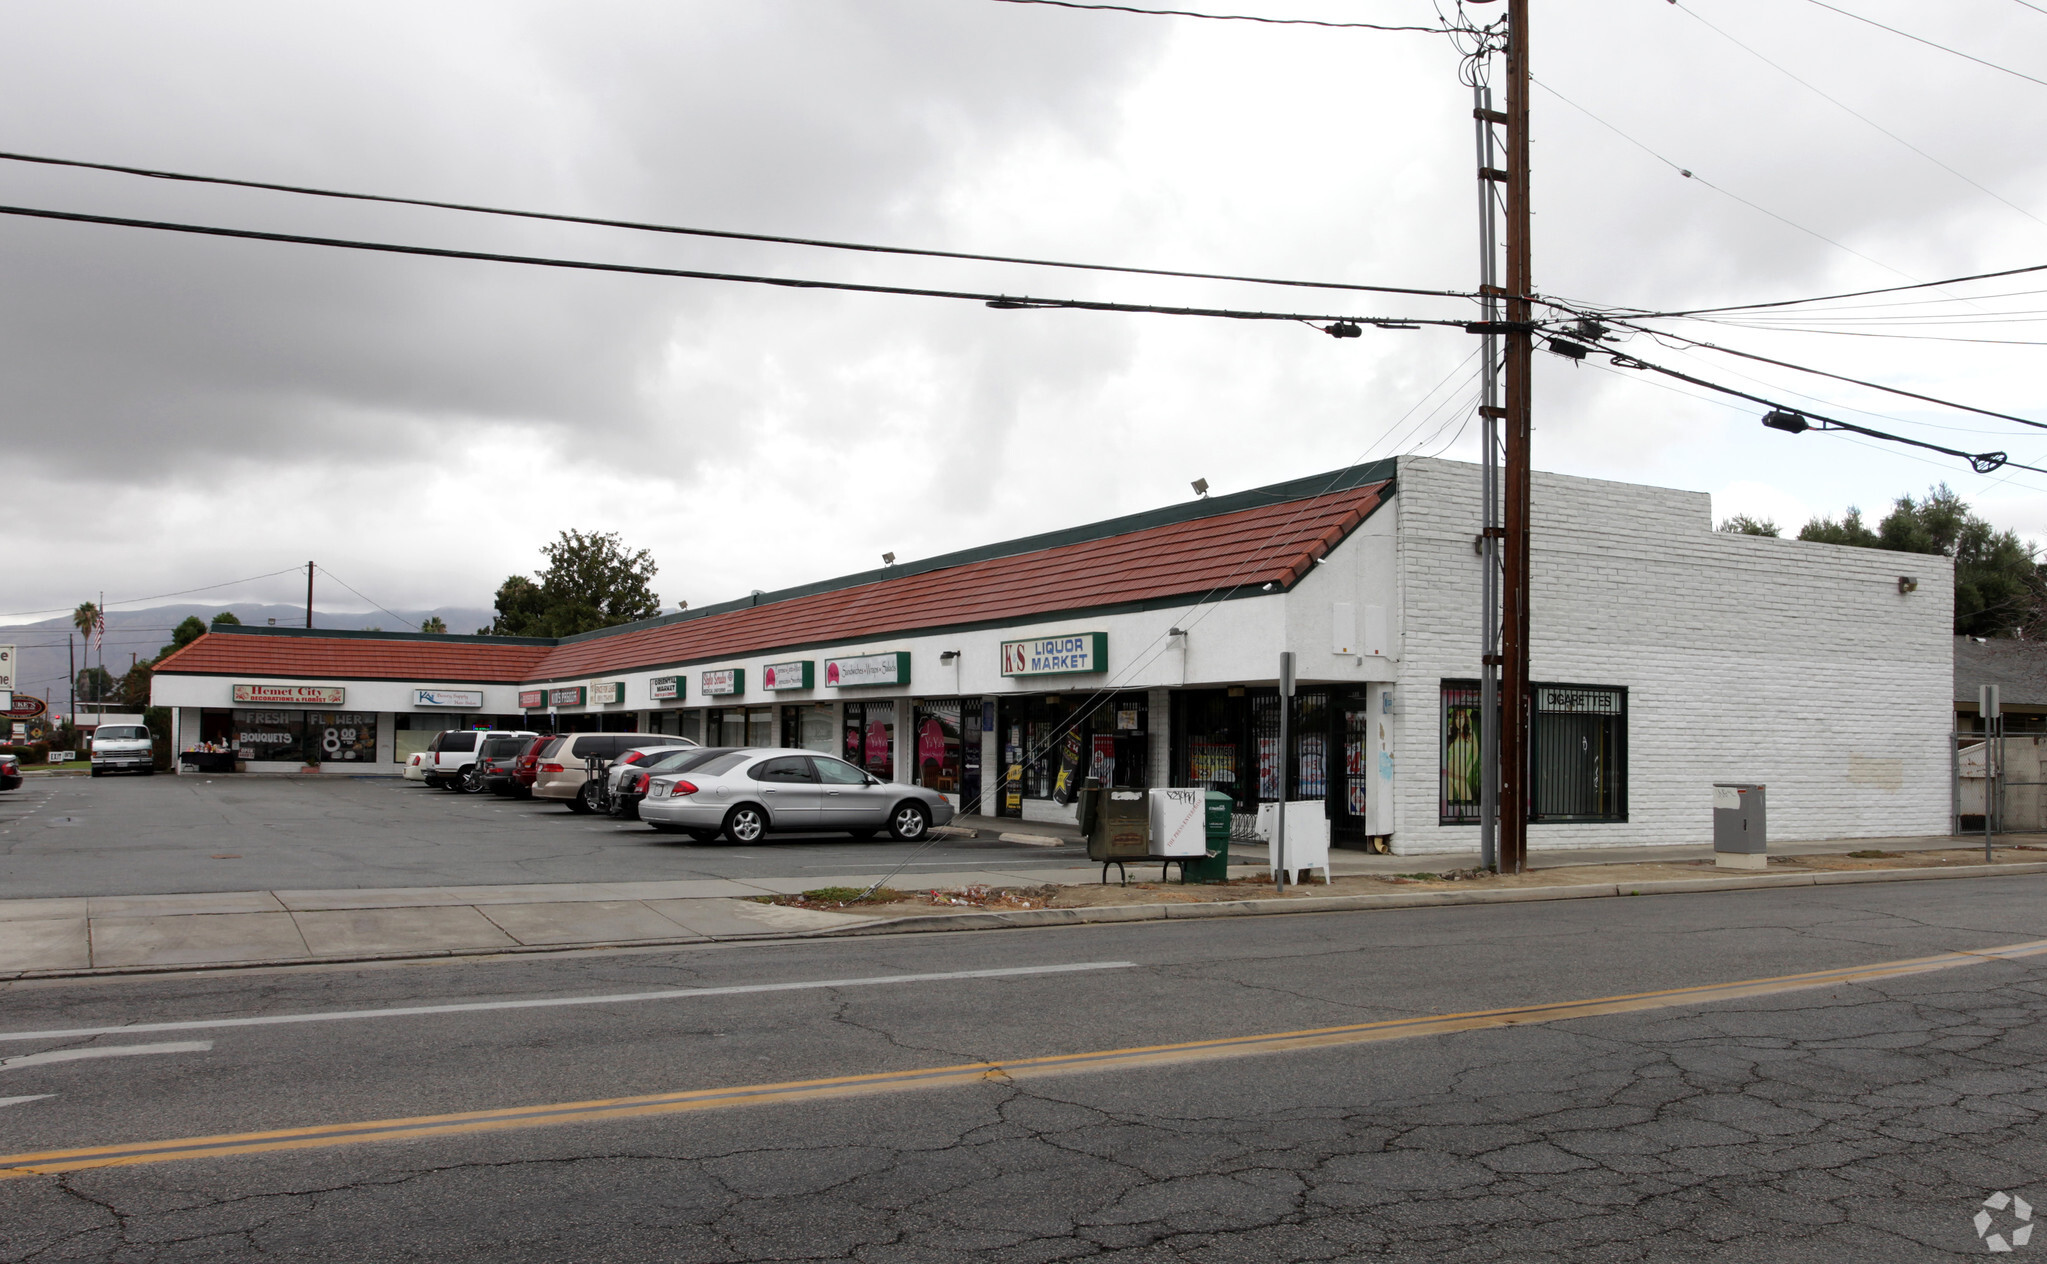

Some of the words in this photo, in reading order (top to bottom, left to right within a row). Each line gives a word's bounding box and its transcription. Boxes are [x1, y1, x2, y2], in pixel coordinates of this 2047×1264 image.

[1035, 638, 1083, 655] LIQUOR
[882, 661, 897, 675] Salads
[1031, 654, 1088, 671] MARKET
[655, 677, 677, 686] ORIENTAL
[251, 686, 292, 696] Hemet
[298, 687, 323, 697] City
[12, 701, 36, 709] UKE'S
[1547, 693, 1612, 708] CIGARETTES
[246, 712, 289, 724] FRESH
[240, 732, 292, 744] BOUQUETS
[322, 728, 340, 753] 8
[51, 753, 62, 761] EXIT
[1192, 745, 1235, 757] UNLIMITED
